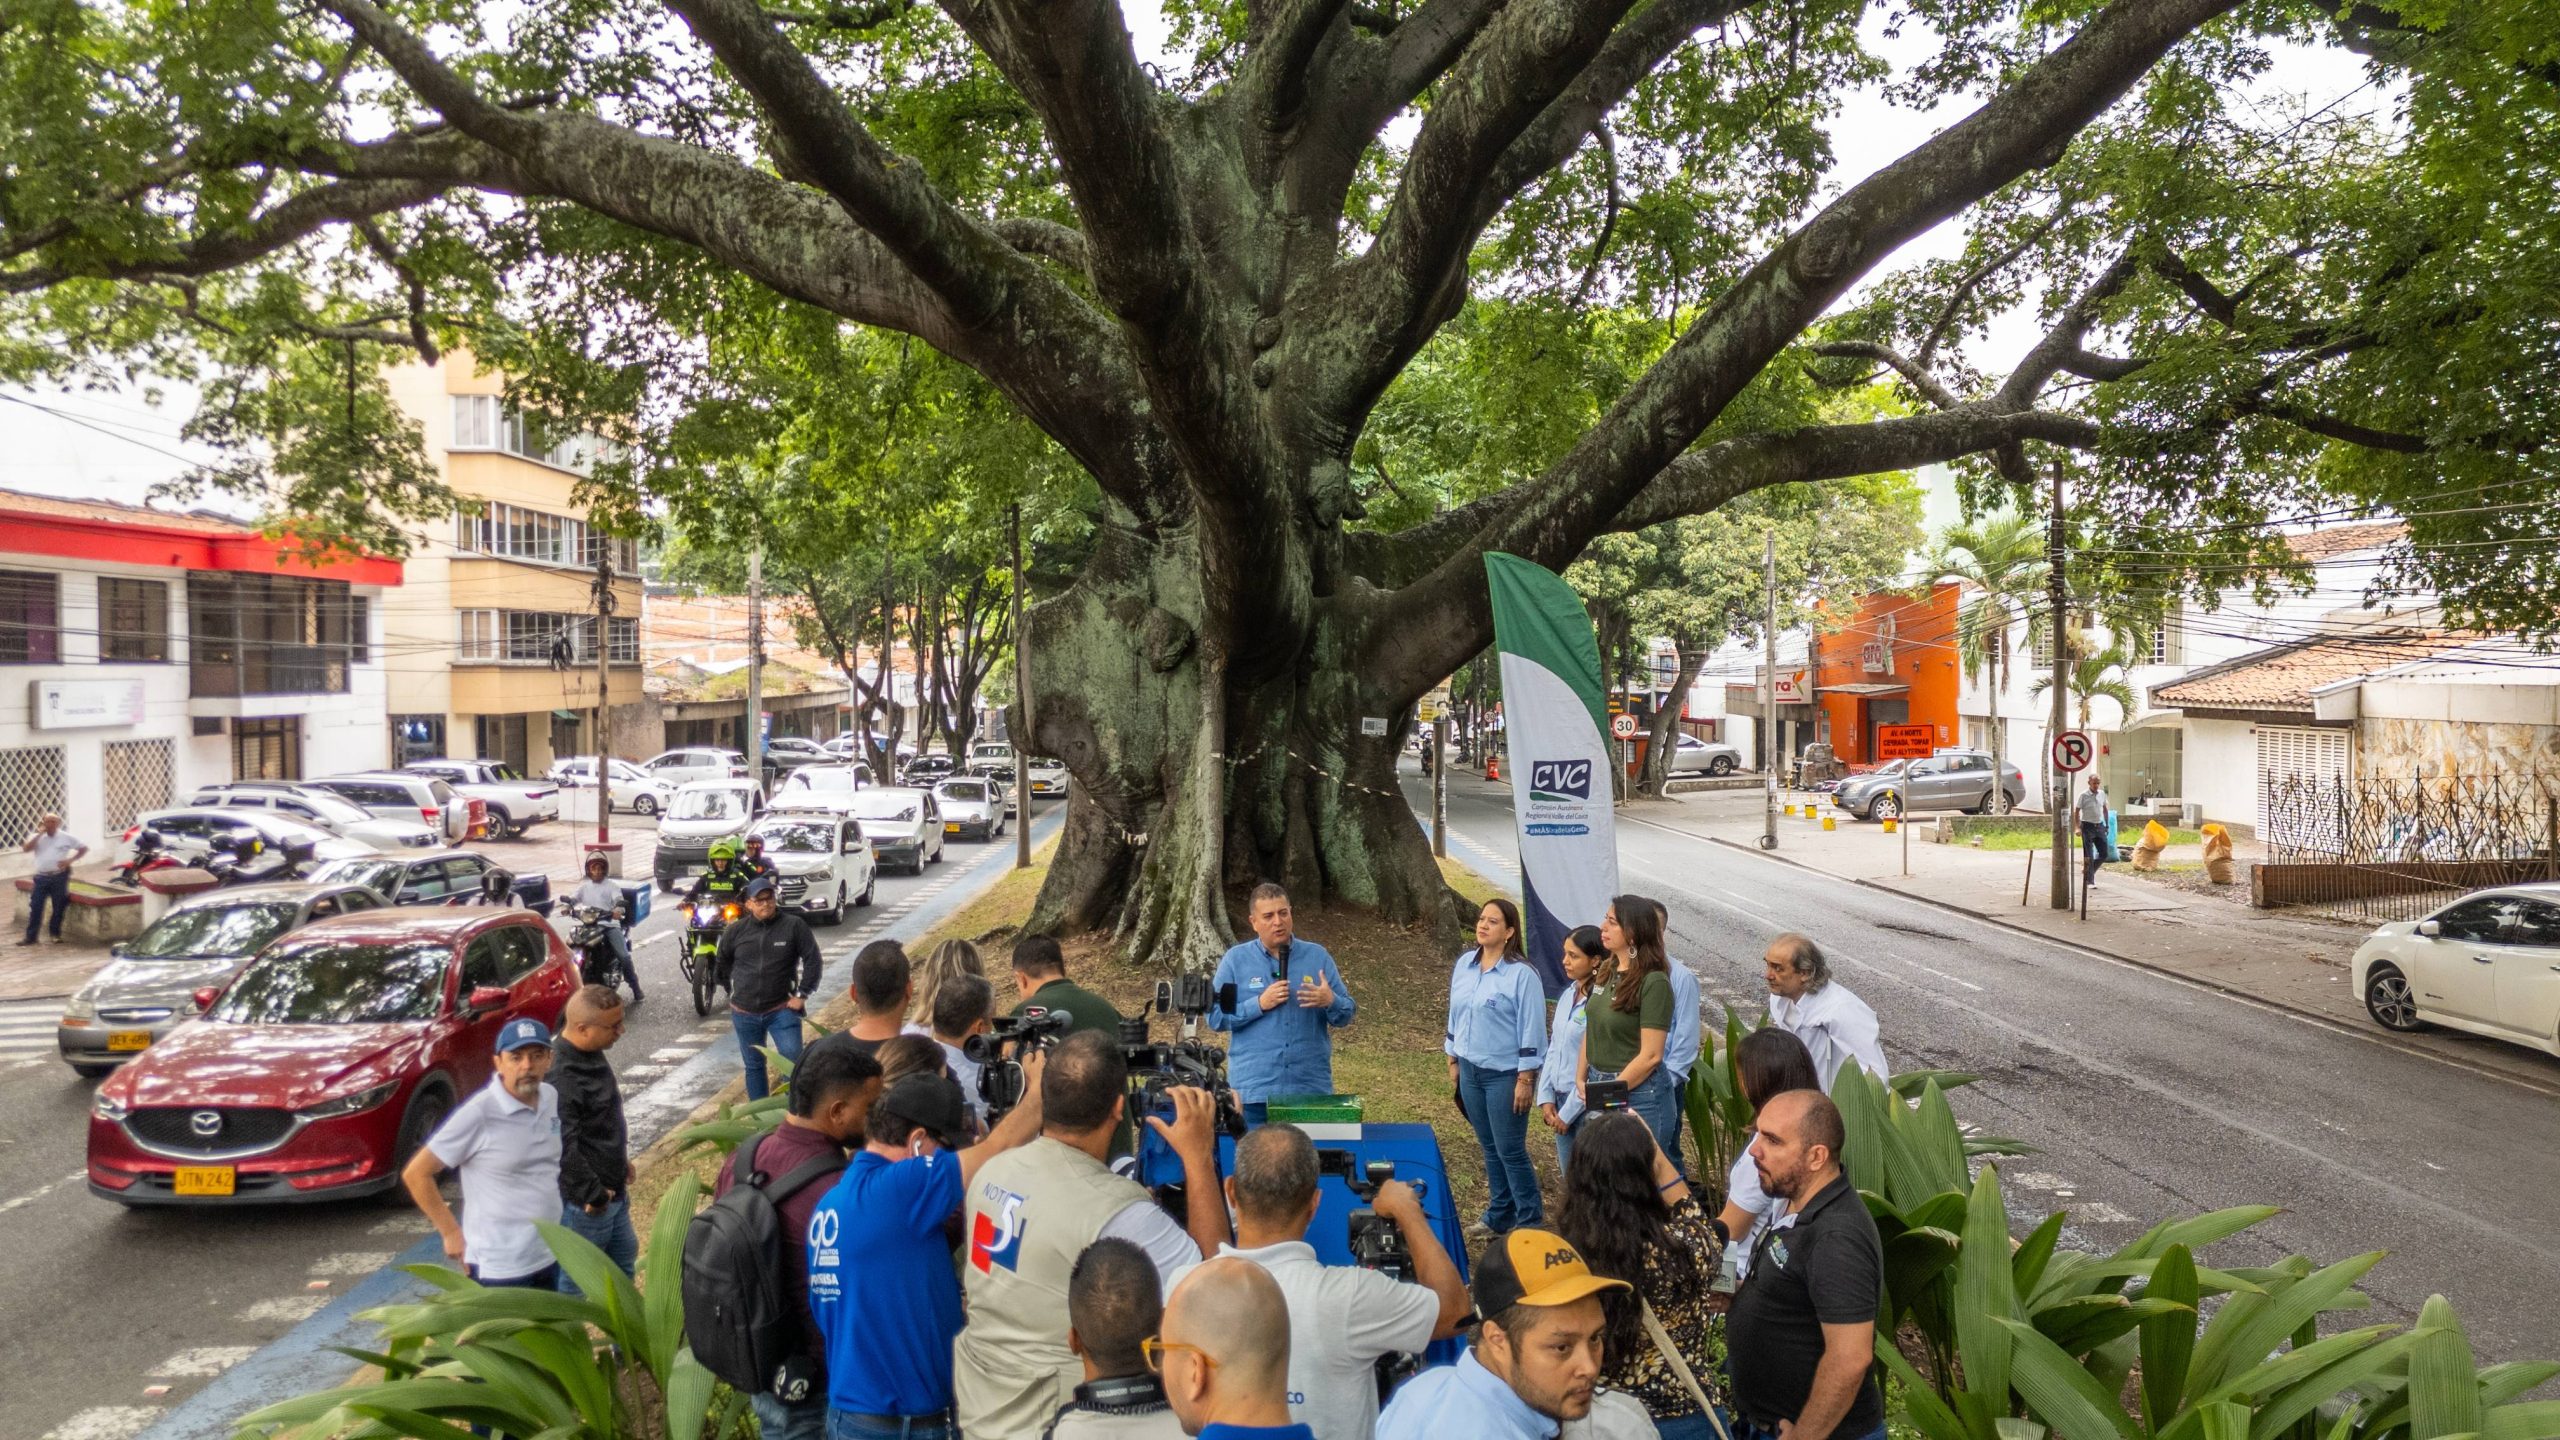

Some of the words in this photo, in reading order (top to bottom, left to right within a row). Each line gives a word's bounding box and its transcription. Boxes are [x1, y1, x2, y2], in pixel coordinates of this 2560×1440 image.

[1616, 720, 1633, 732] 30
[2066, 740, 2085, 765] P
[1535, 764, 1588, 790] CVC
[179, 1172, 204, 1187] JTN
[206, 1172, 233, 1187] 242
